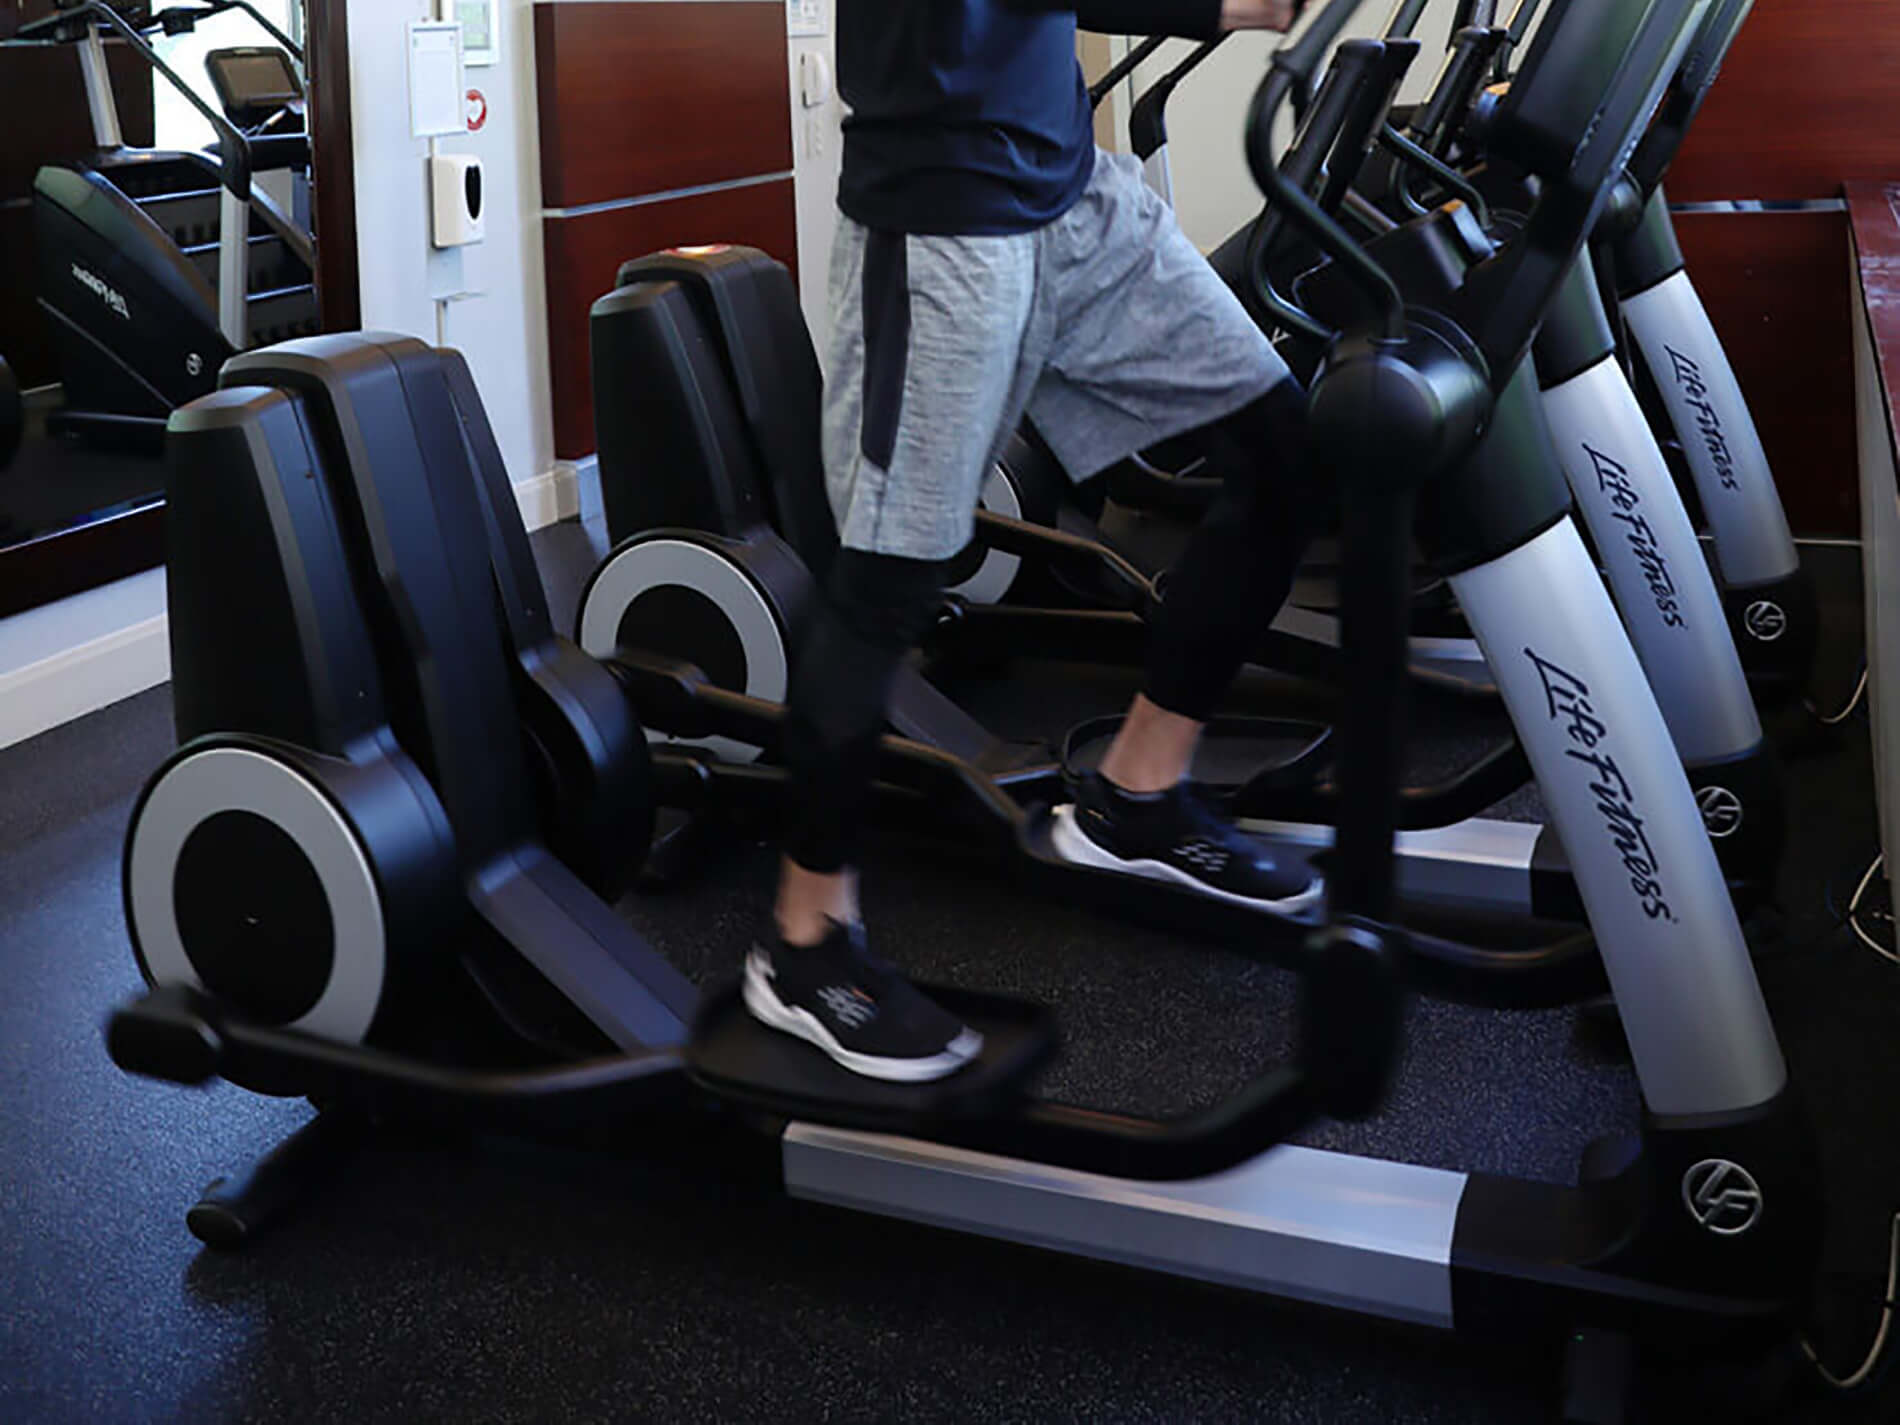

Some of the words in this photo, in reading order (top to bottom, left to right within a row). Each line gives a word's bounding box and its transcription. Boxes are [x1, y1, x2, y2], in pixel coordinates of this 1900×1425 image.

[1582, 443, 1638, 511] Life
[1612, 513, 1684, 628] Fitness
[1524, 647, 1606, 748] Life
[1565, 748, 1671, 920] Fitness
